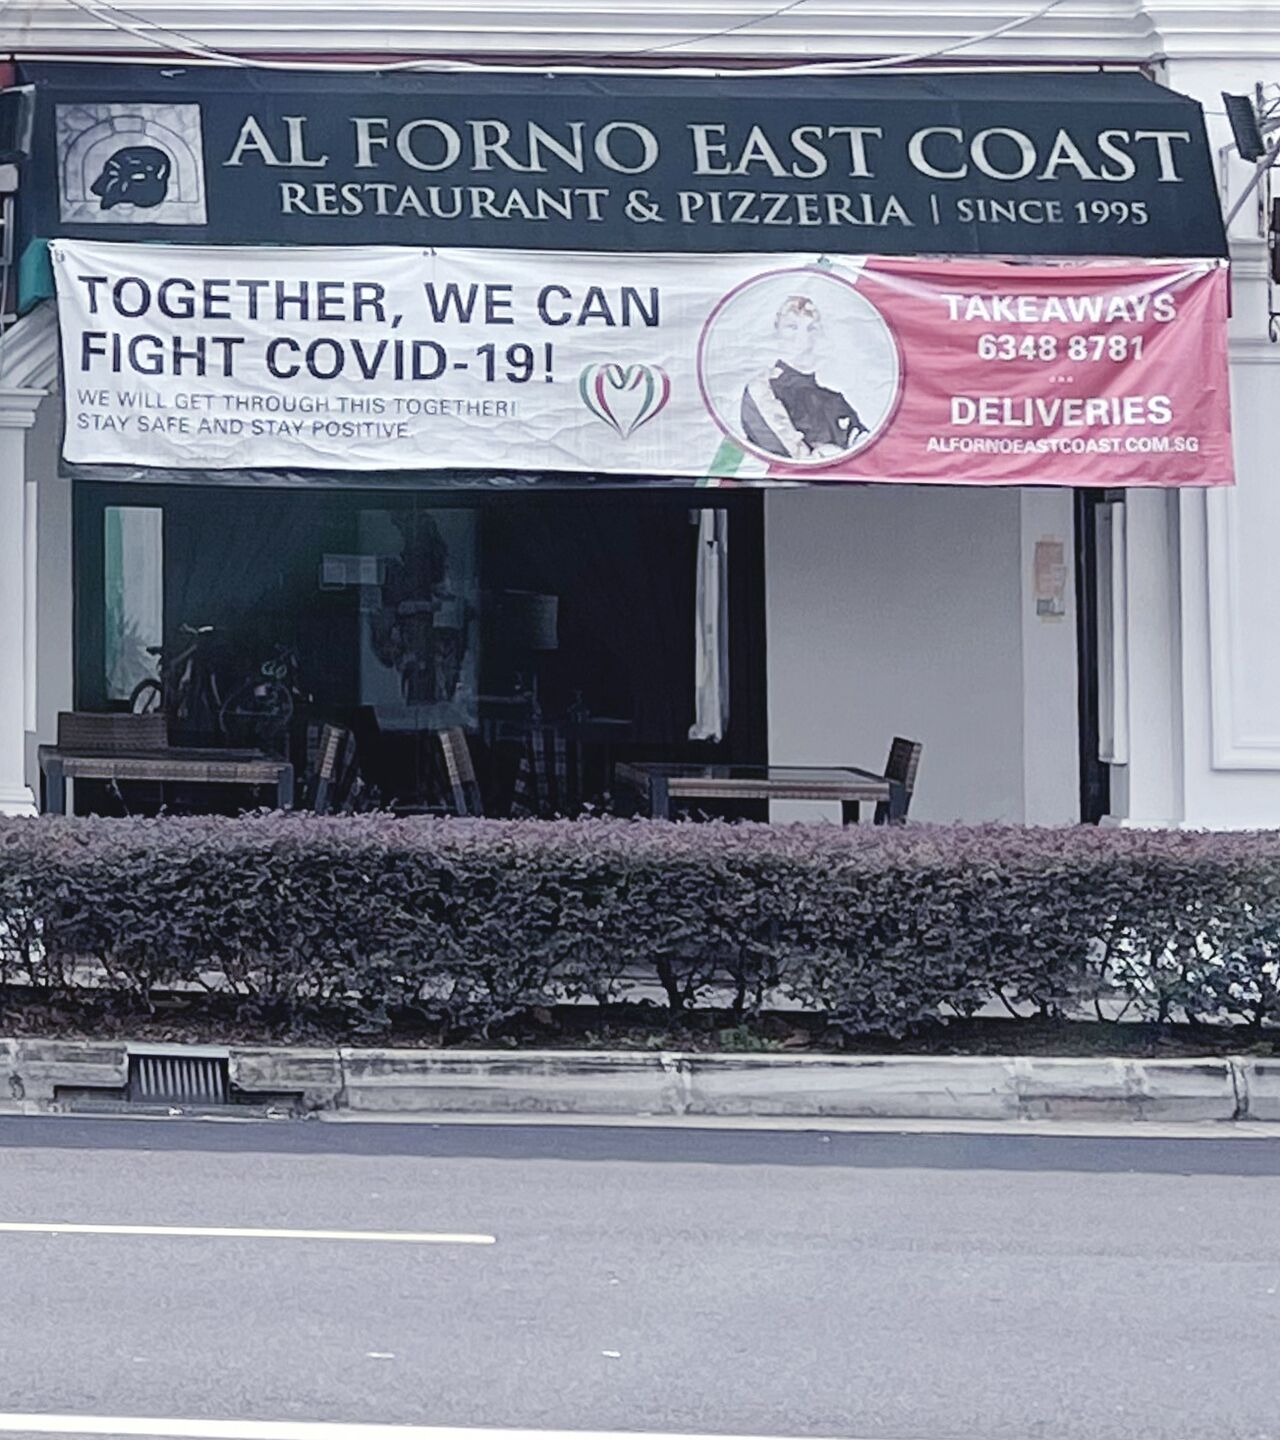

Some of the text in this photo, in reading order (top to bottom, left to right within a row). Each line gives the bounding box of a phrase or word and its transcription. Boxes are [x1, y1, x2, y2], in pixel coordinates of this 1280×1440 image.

[223, 115, 1190, 183] AL FORNO EAST COAST
[280, 182, 1149, 227] RESTAURANT & PIZZERIA SINCE 1995
[77, 275, 659, 329] TOGETHER, WE CAN
[940, 293, 1177, 323] TAKEAWAYS
[80, 330, 554, 384] FIGHT COVID-19!
[977, 333, 1144, 362] 6348 8781
[77, 389, 110, 407] WE
[117, 390, 167, 409] WILL
[175, 392, 214, 410] GET
[222, 394, 330, 414] THROUGH
[339, 396, 386, 415] THIS
[949, 395, 1173, 428] DELIVERIES
[77, 412, 129, 431] STAY
[138, 415, 190, 433] SAFE
[197, 417, 244, 435] AND
[251, 419, 303, 436] STAY
